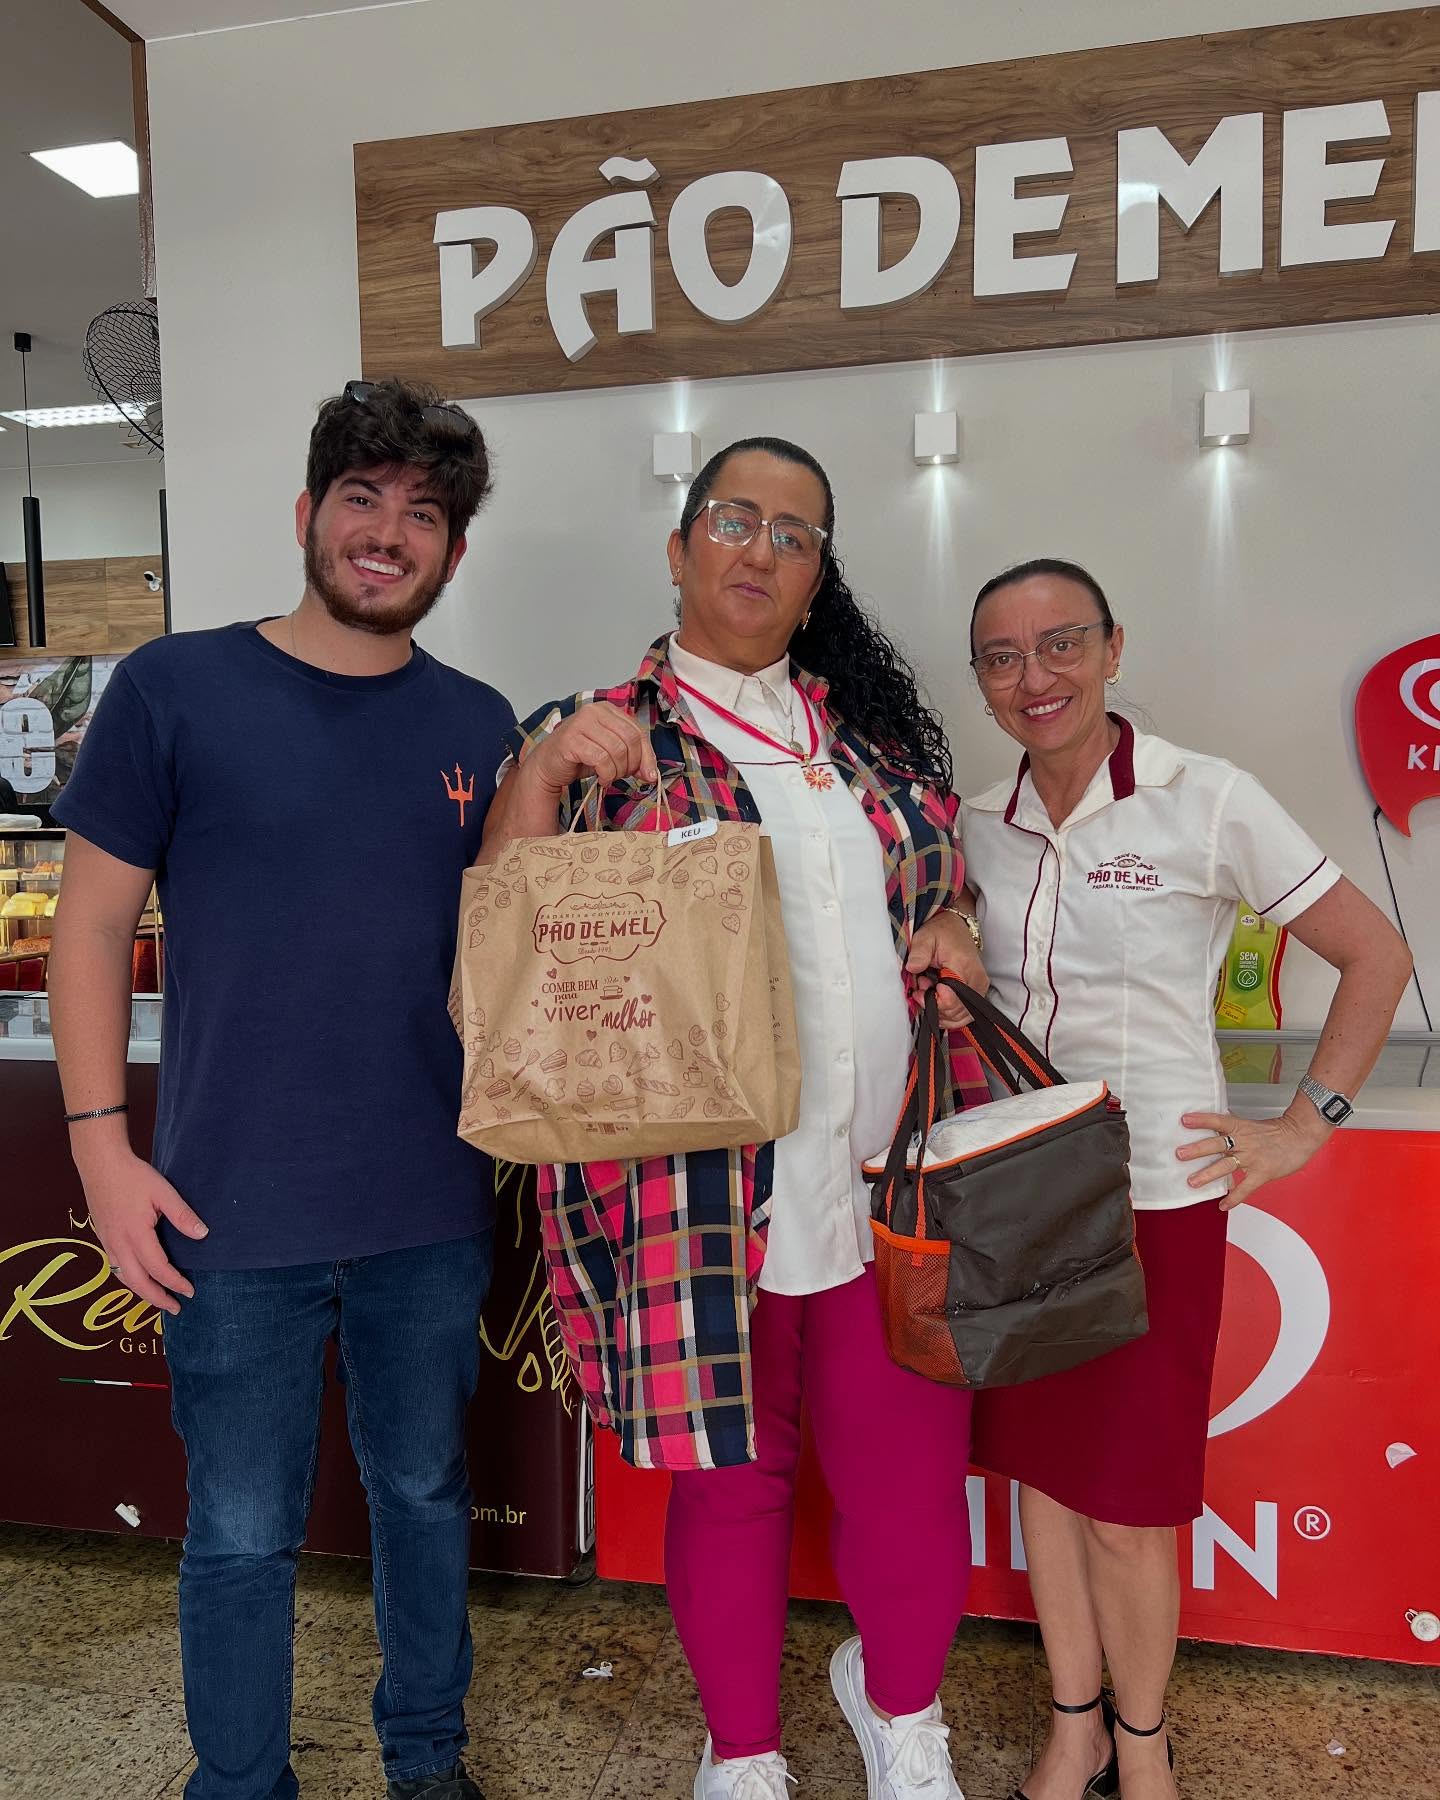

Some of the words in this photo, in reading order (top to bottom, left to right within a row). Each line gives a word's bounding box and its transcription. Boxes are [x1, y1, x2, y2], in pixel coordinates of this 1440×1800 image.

[433, 156, 792, 362] PÃO
[836, 137, 1077, 313] DE
[1087, 870, 1110, 883] PÃO
[1114, 871, 1131, 883] DE
[1135, 872, 1163, 887] MEL
[538, 921, 576, 943] PÃO
[580, 920, 606, 940] DE
[610, 916, 655, 938] MEL
[541, 982, 576, 994] COMER
[578, 980, 598, 991] BEM
[554, 993, 578, 1004] para
[544, 1000, 600, 1023] viver
[601, 997, 656, 1032] melhor
